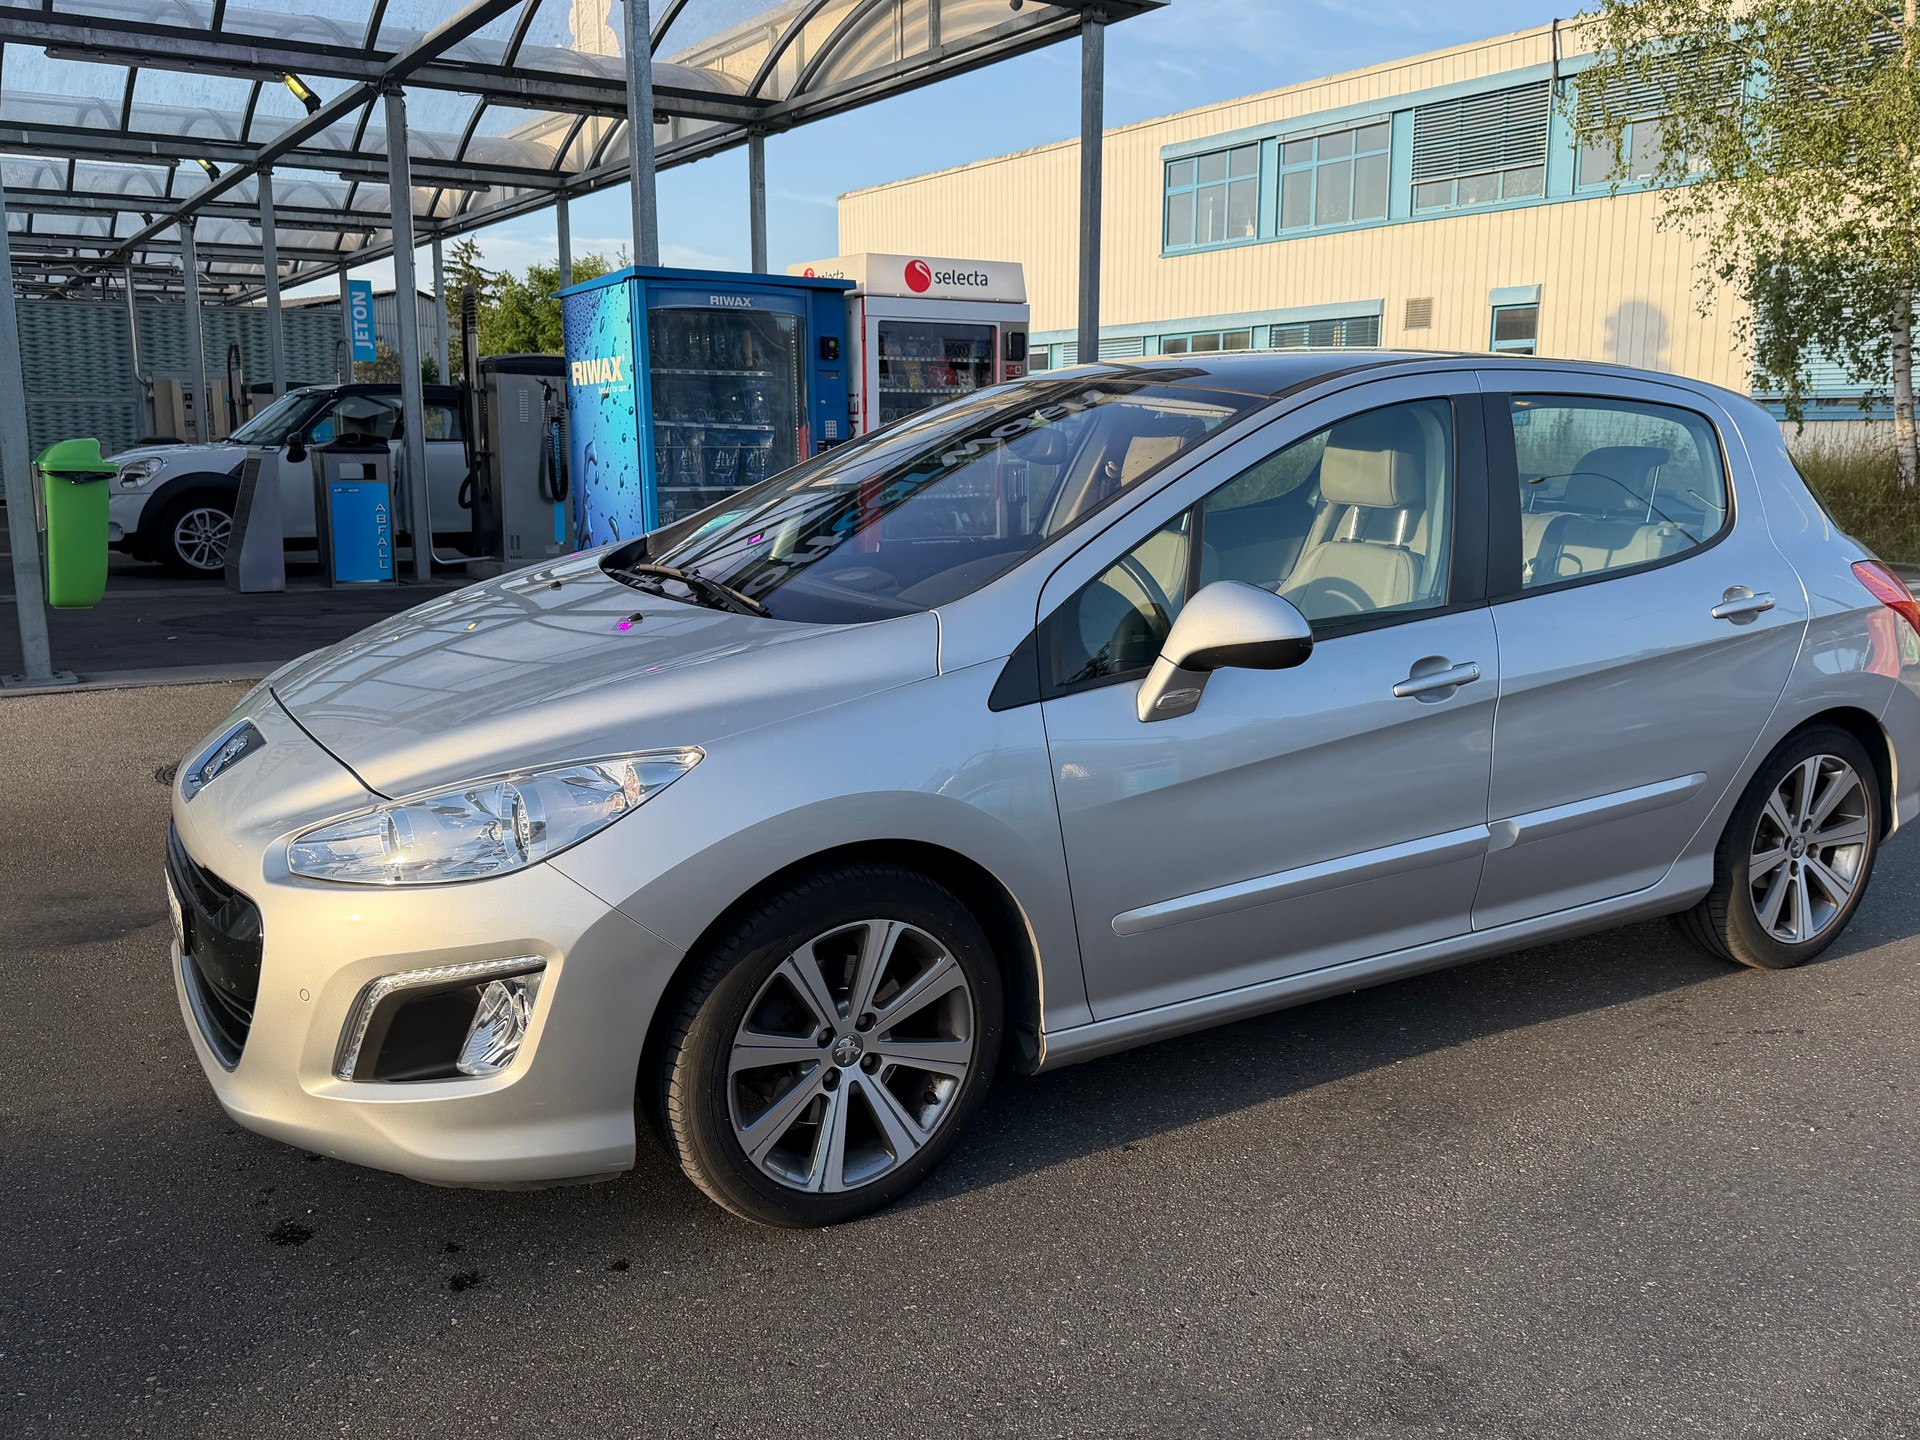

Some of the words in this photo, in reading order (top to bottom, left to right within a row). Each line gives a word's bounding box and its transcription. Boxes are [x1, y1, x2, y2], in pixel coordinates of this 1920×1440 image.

[934, 269, 989, 287] selecta
[709, 295, 752, 307] RIWAX
[351, 291, 374, 350] JETON
[571, 356, 624, 387] RIWAX
[375, 503, 389, 569] ABFALL
